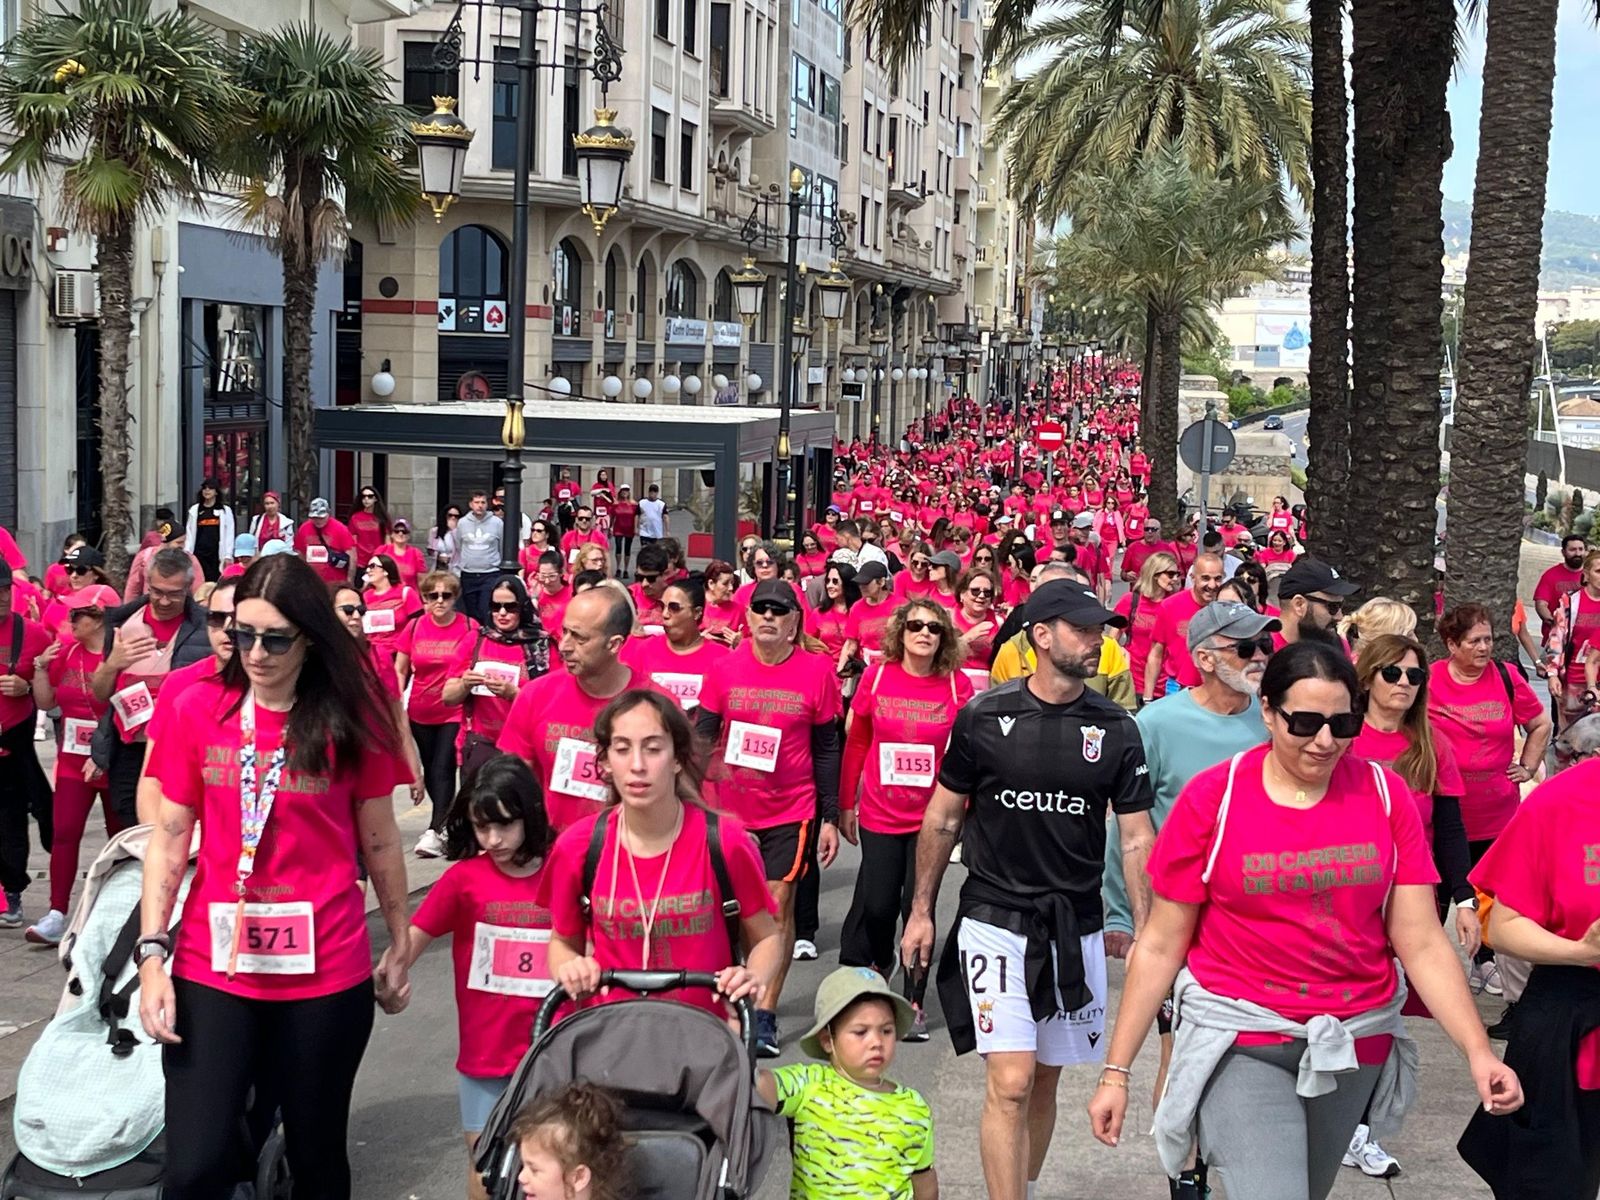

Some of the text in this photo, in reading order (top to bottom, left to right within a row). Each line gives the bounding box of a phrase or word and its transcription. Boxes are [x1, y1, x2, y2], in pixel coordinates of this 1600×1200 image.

[1, 233, 32, 278] OS
[743, 738, 775, 756] 1154
[896, 758, 931, 773] 1153
[1279, 842, 1378, 871] CARRERA
[1244, 864, 1383, 895] DE LA MUJER
[620, 888, 714, 918] CARRERA
[247, 926, 298, 949] 571
[518, 952, 533, 973] 8
[971, 954, 1007, 994] 21
